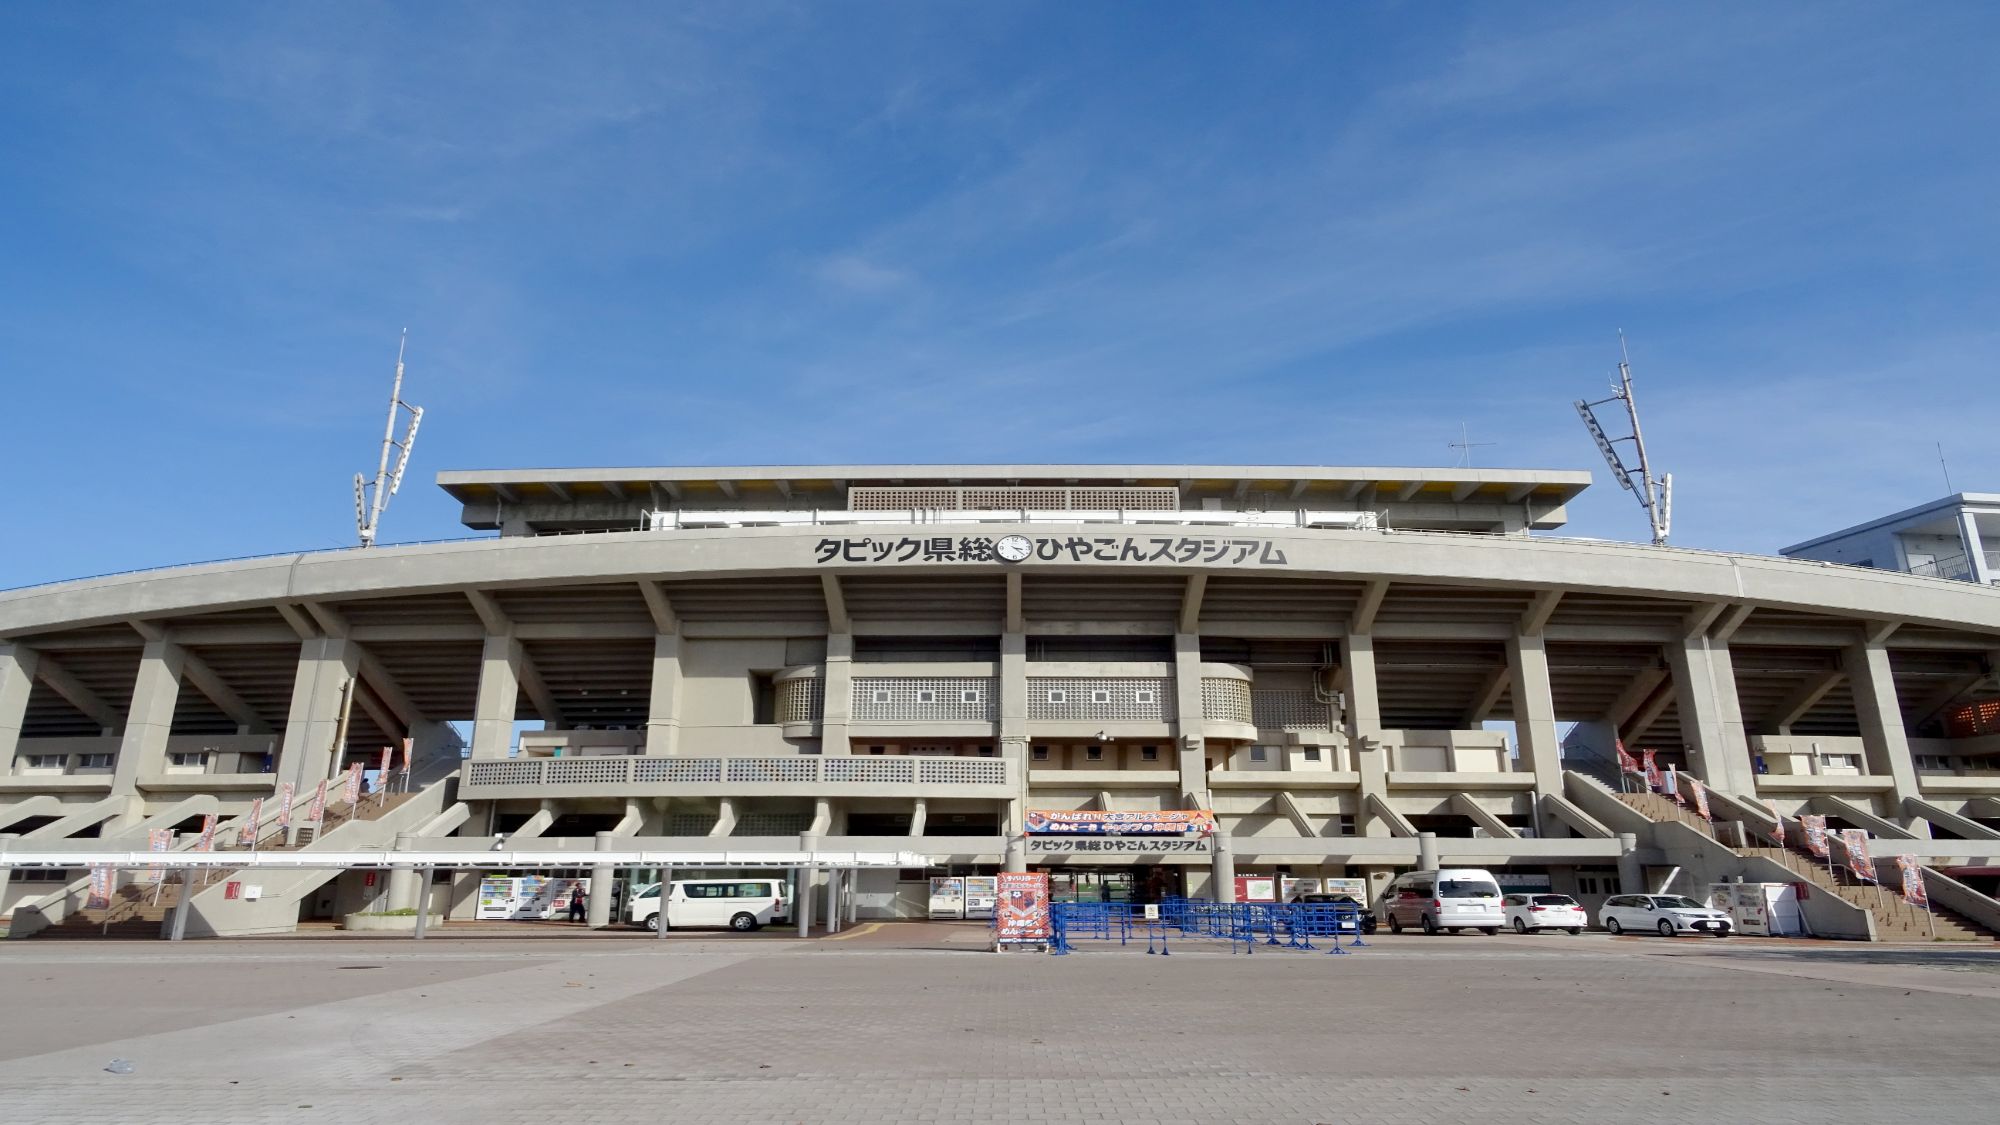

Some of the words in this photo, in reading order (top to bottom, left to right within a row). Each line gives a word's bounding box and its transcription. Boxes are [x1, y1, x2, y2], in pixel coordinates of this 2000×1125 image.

[814, 536, 994, 564] タピック県総
[1035, 536, 1288, 566] ひやごんスタジアム
